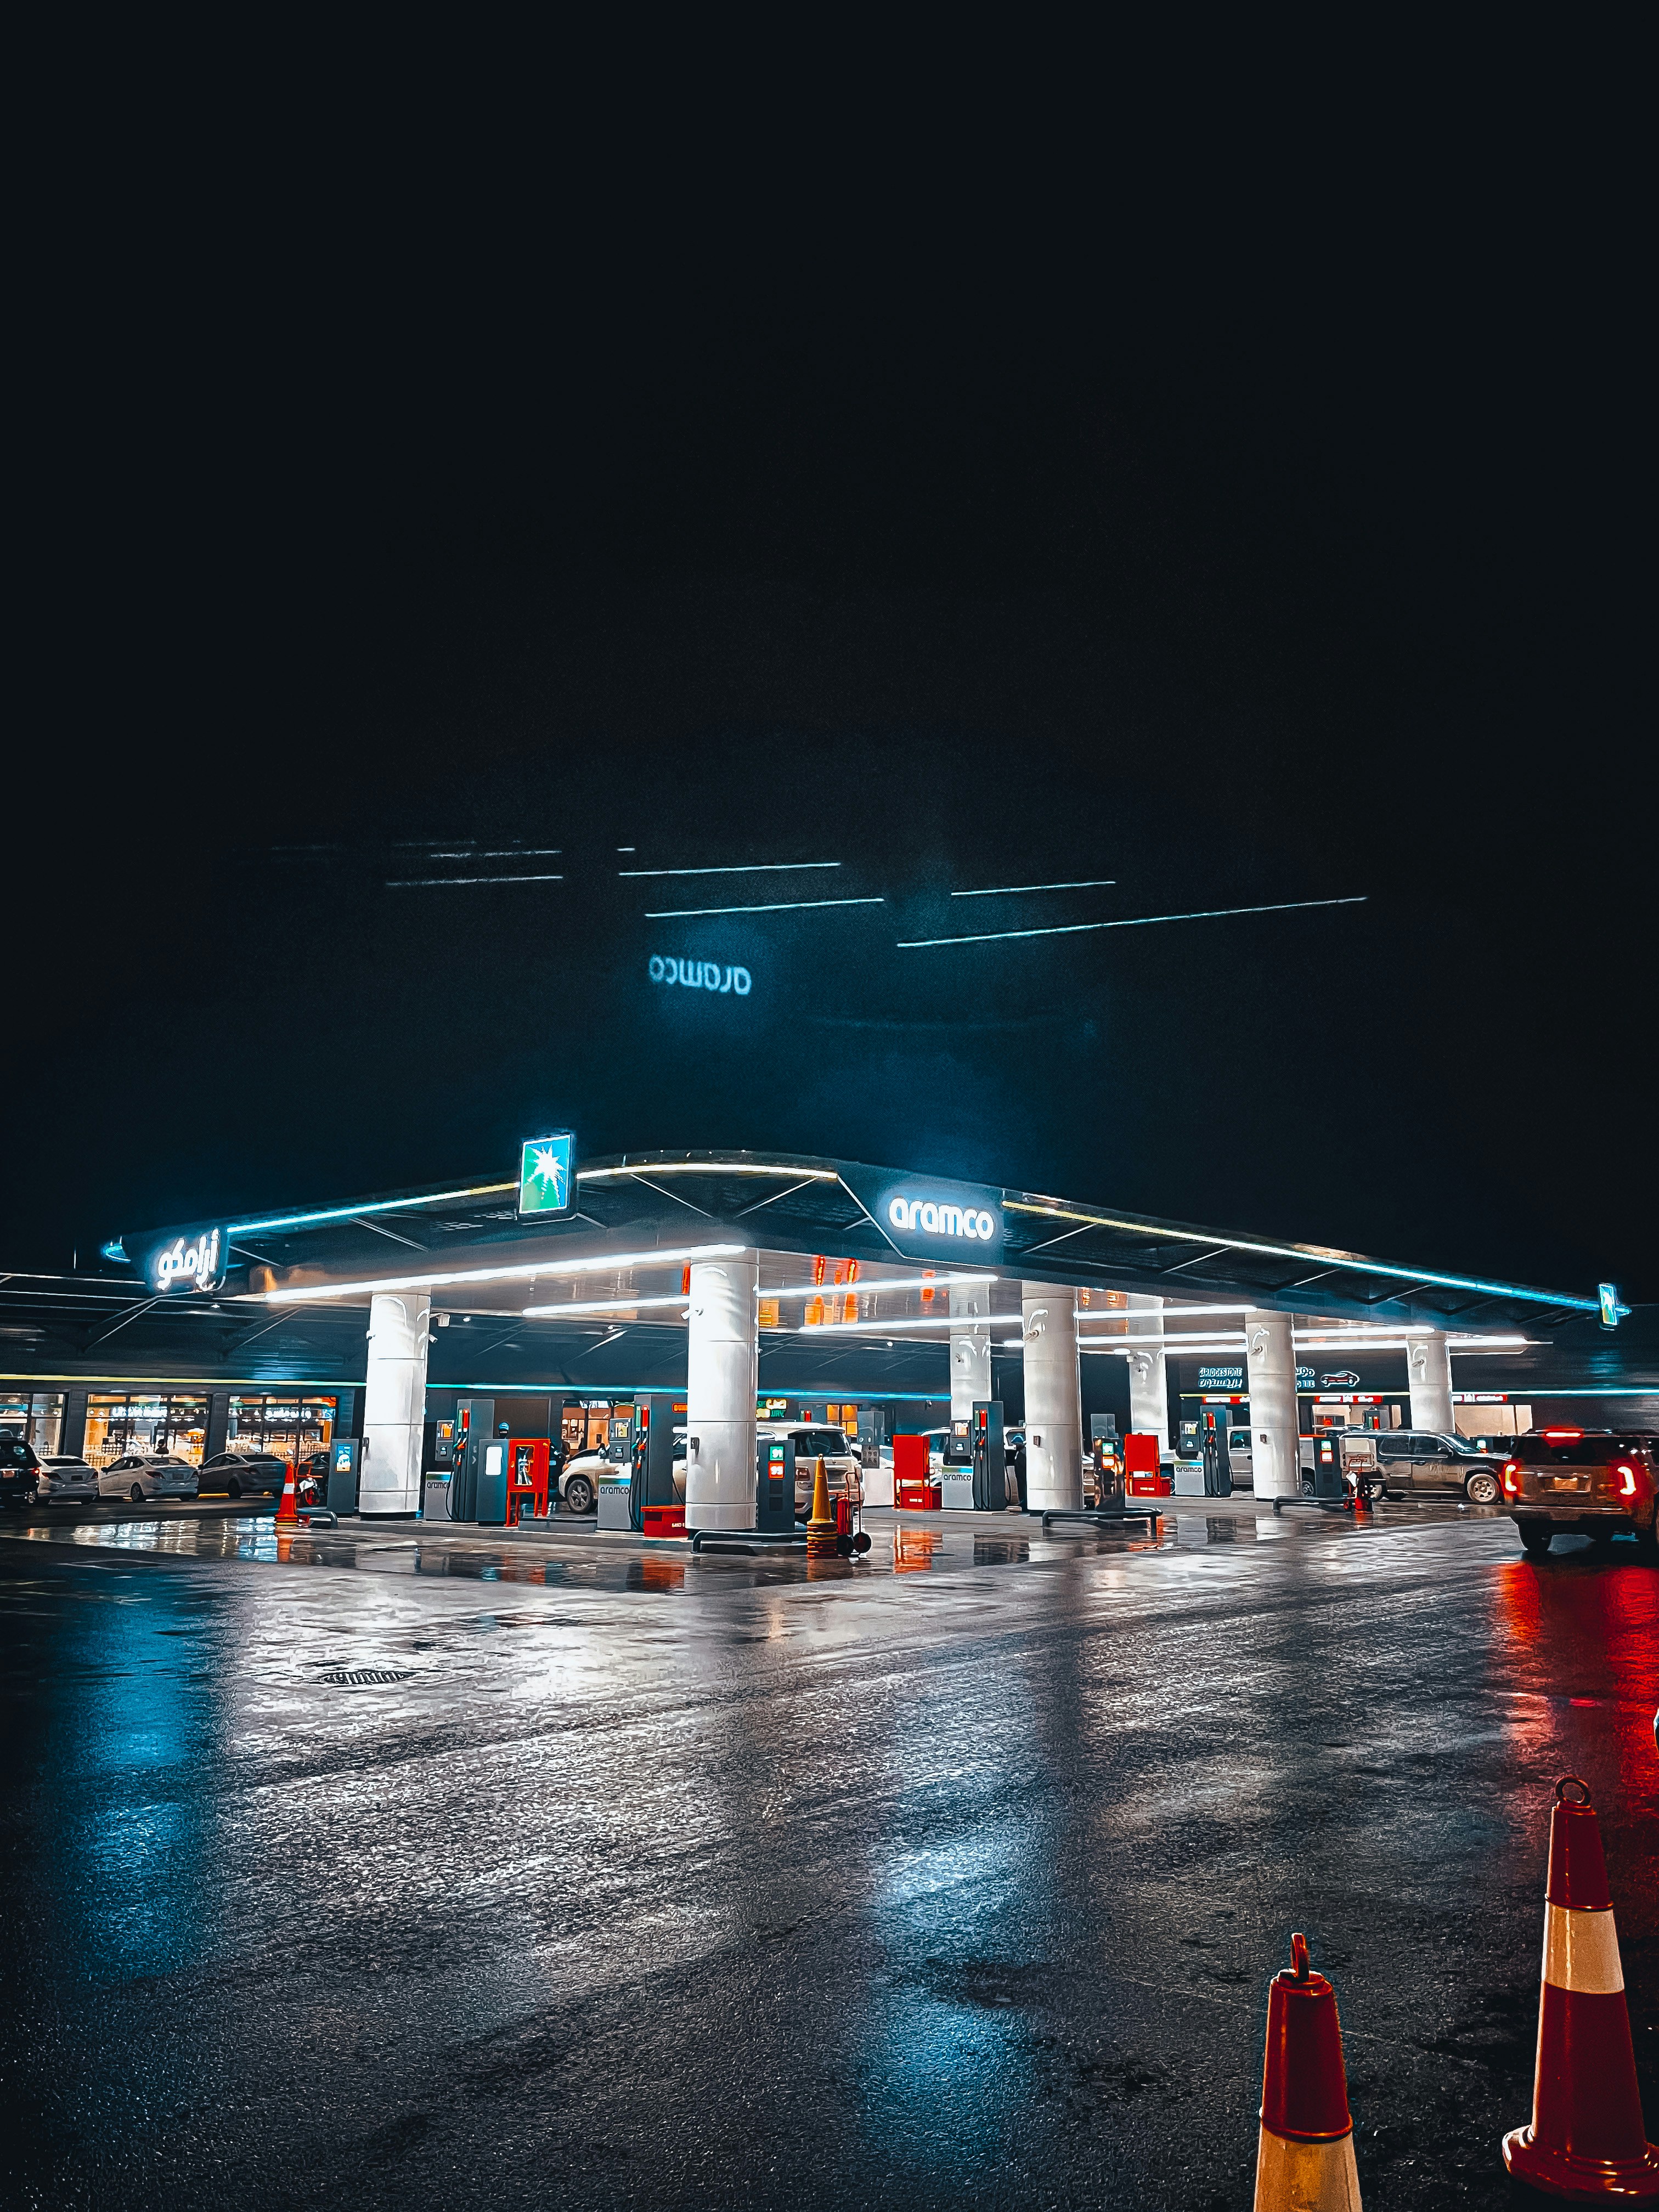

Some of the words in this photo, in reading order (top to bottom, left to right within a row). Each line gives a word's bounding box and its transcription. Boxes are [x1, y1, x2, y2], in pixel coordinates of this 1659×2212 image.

[649, 955, 751, 995] aramco
[889, 1197, 995, 1240] aramco
[600, 1486, 629, 1495] aramco
